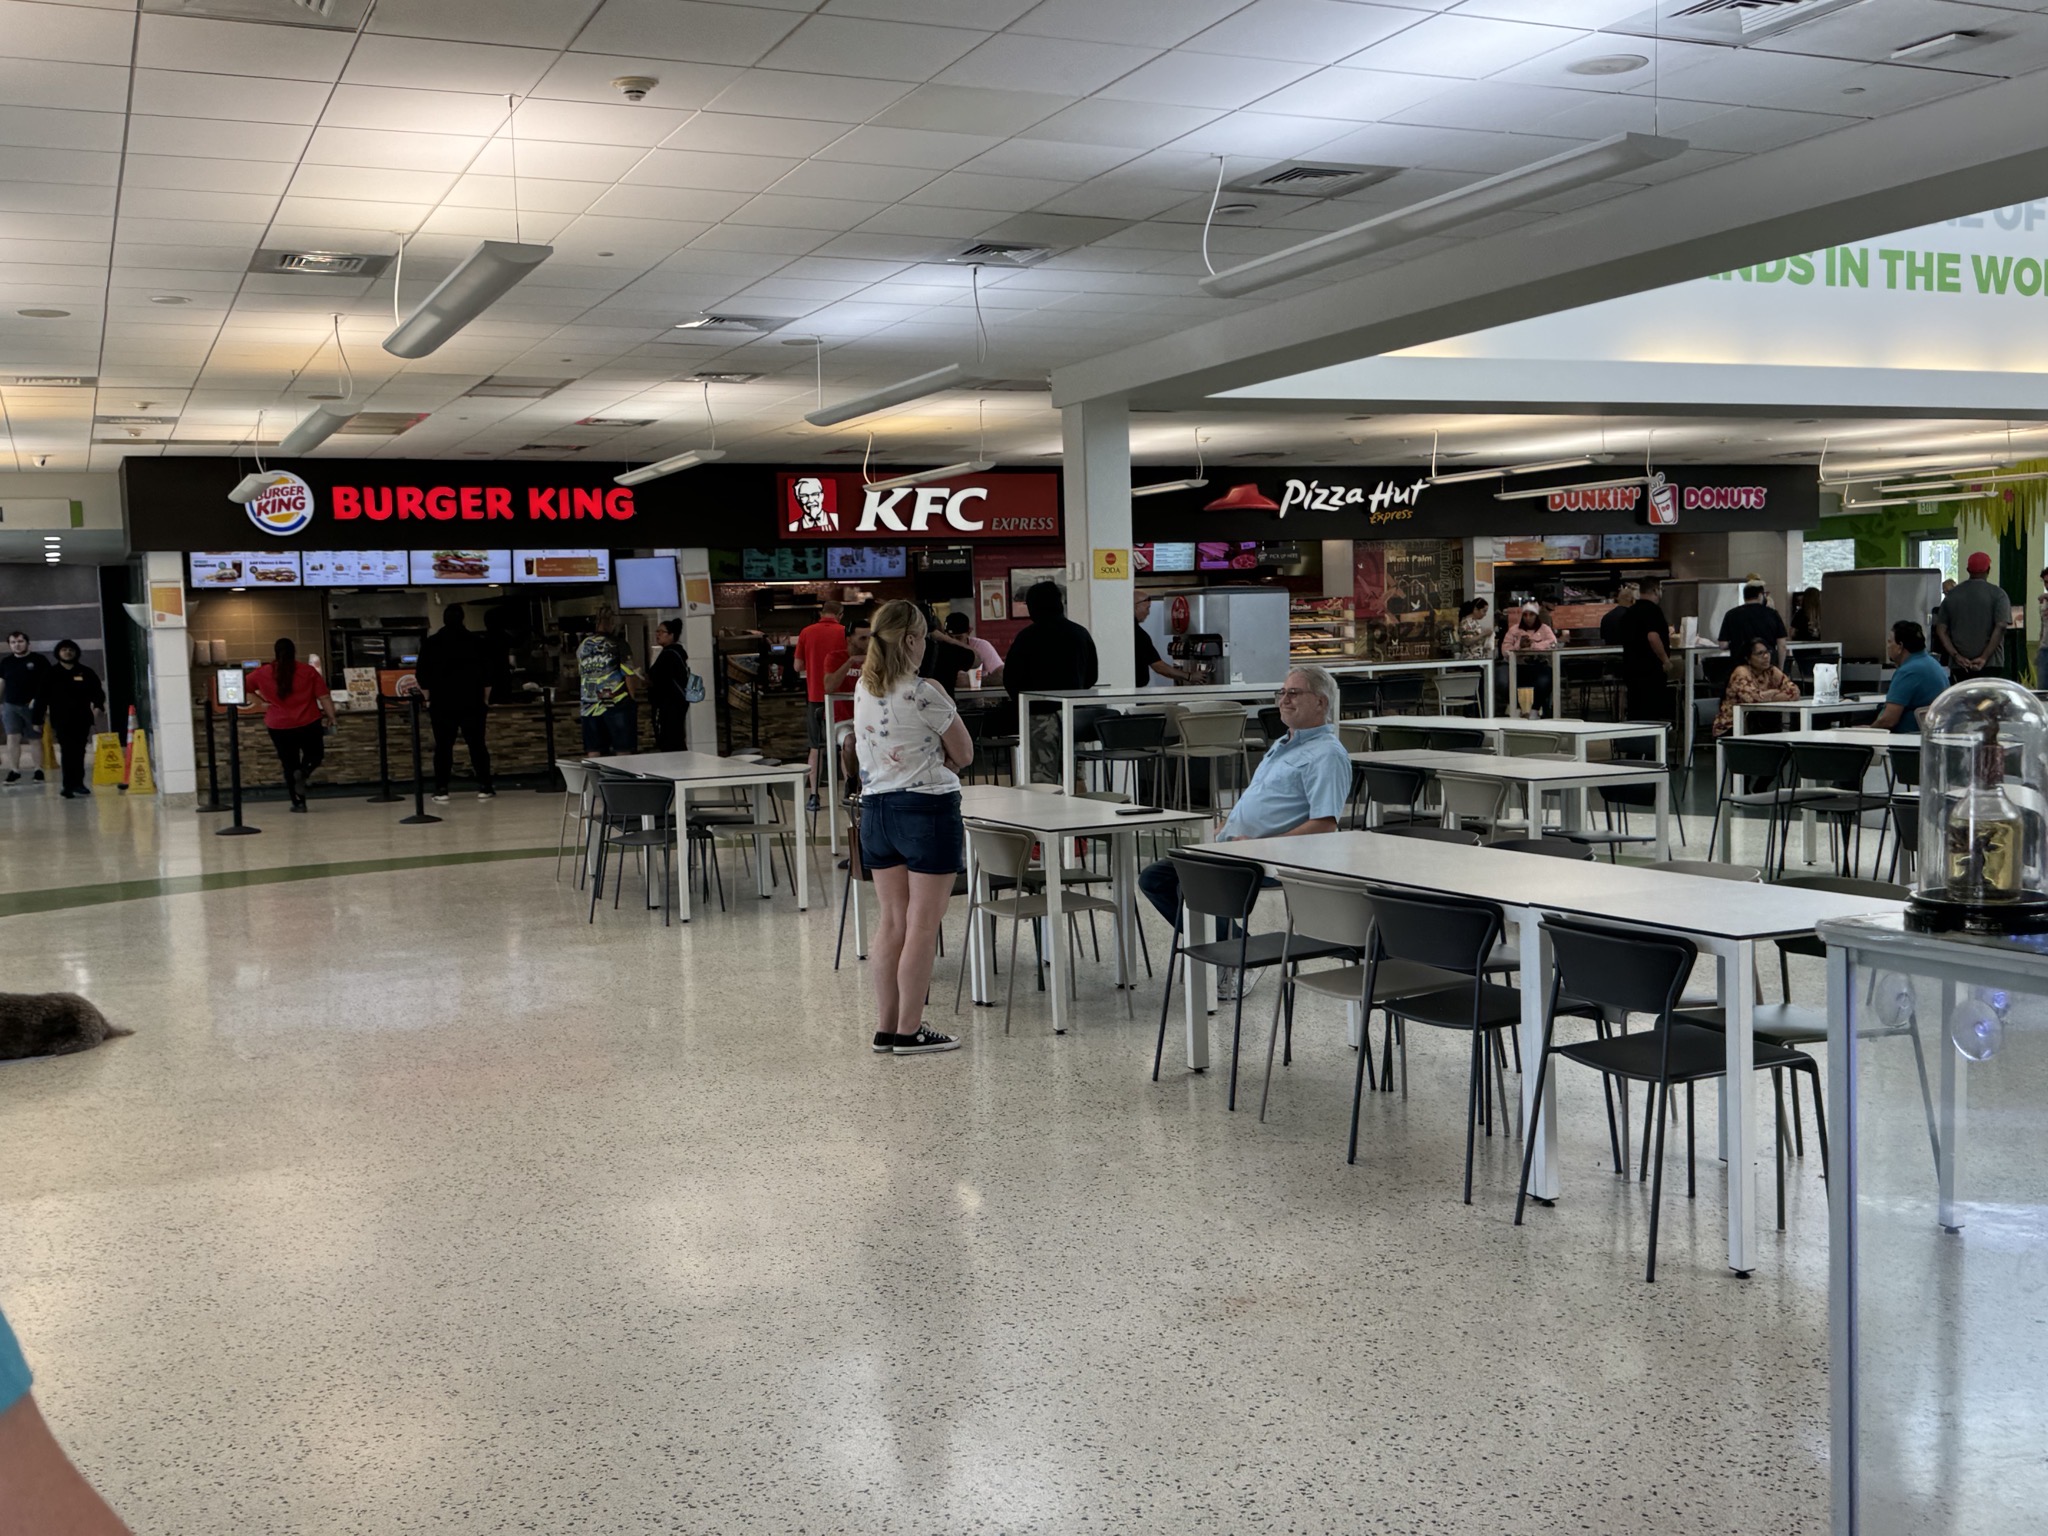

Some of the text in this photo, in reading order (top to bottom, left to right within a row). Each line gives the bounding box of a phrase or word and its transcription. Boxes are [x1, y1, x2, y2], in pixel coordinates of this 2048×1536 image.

[1825, 246, 1869, 288] IN
[1879, 248, 1961, 293] THE
[1971, 254, 2048, 297] WO
[256, 496, 305, 517] KING
[332, 486, 634, 520] BURGER KING
[855, 487, 988, 531] KFC
[1279, 478, 1430, 519] Pizza Hut
[1548, 487, 1641, 511] DUNKIN'
[1684, 486, 1767, 509] DONUTS
[991, 517, 1054, 531] EXPRESS
[1369, 509, 1413, 525] Express
[1412, 555, 1433, 563] Palm
